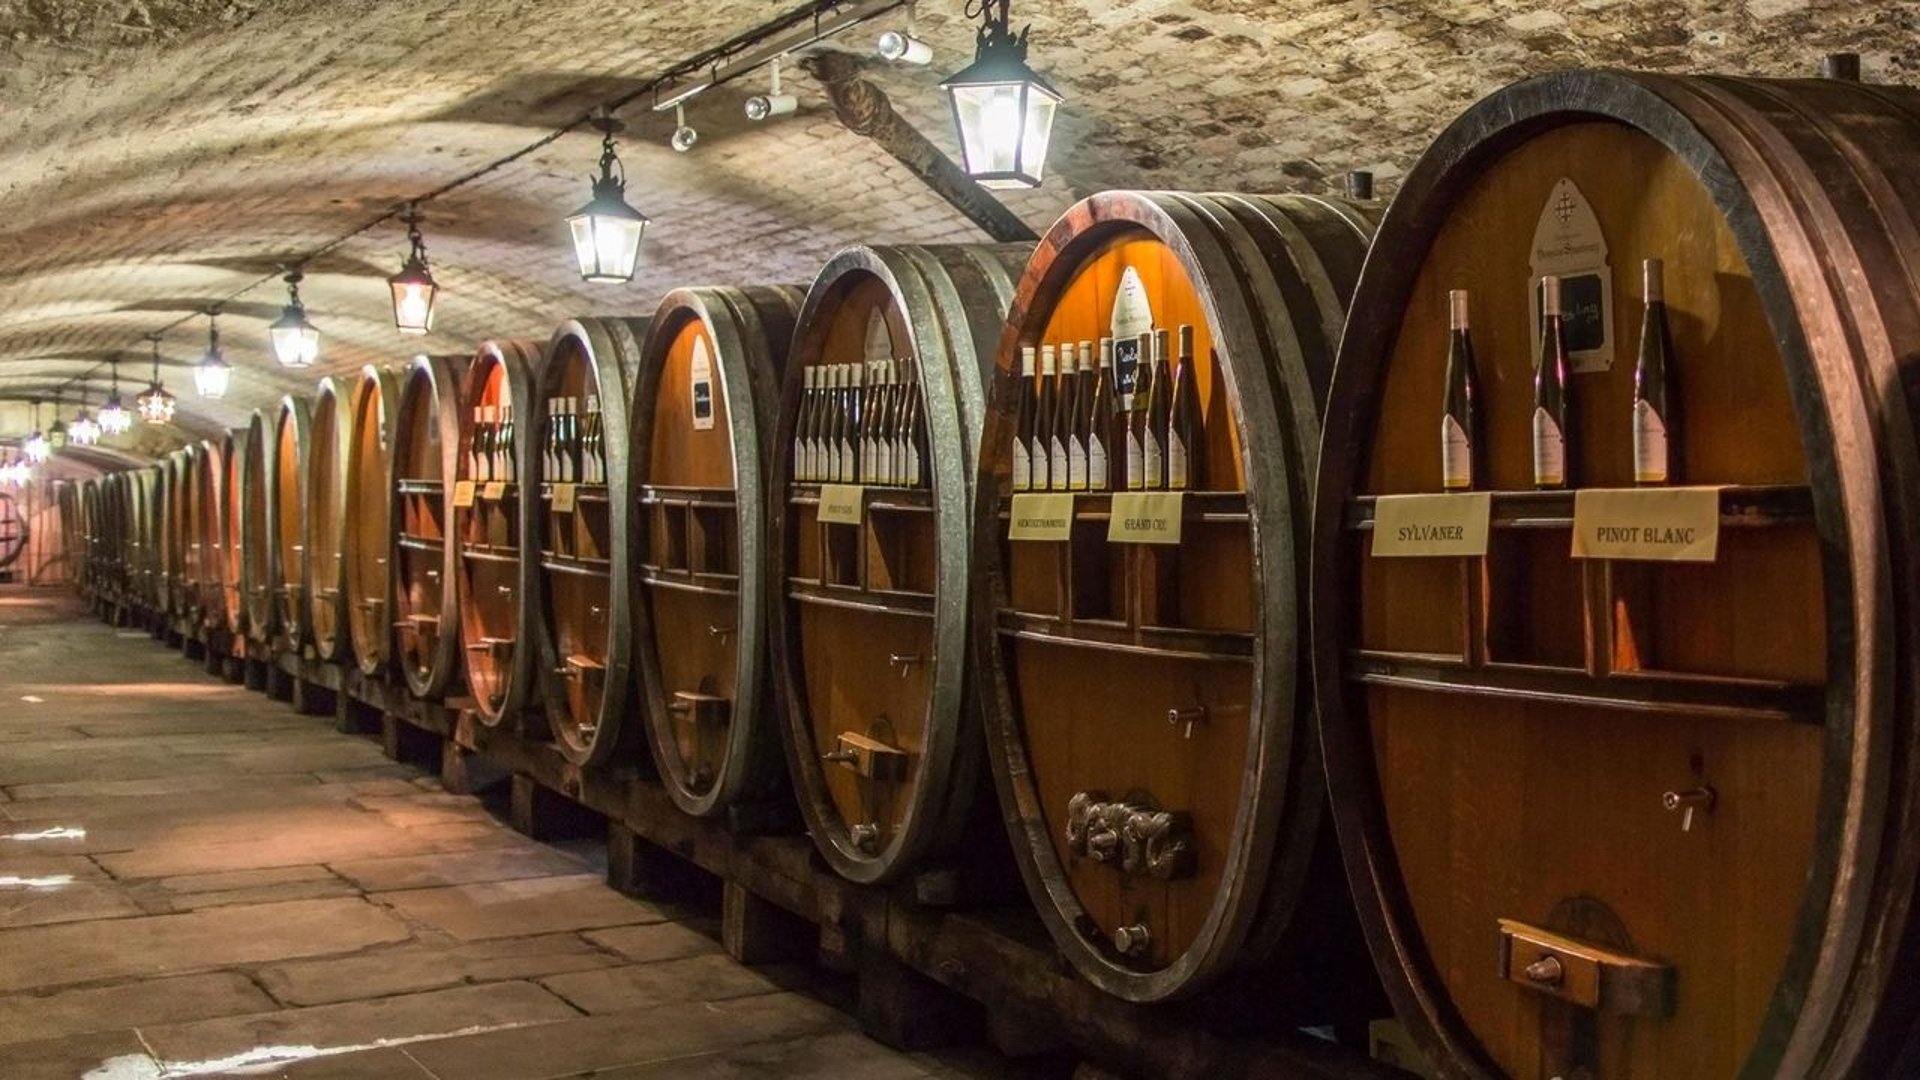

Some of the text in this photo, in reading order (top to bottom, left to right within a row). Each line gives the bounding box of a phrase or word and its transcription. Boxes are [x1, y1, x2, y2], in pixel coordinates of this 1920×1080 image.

[1124, 518, 1151, 531] GRAND
[1398, 524, 1464, 541] SYLVANER
[1596, 526, 1696, 545] PINOT BLANC
